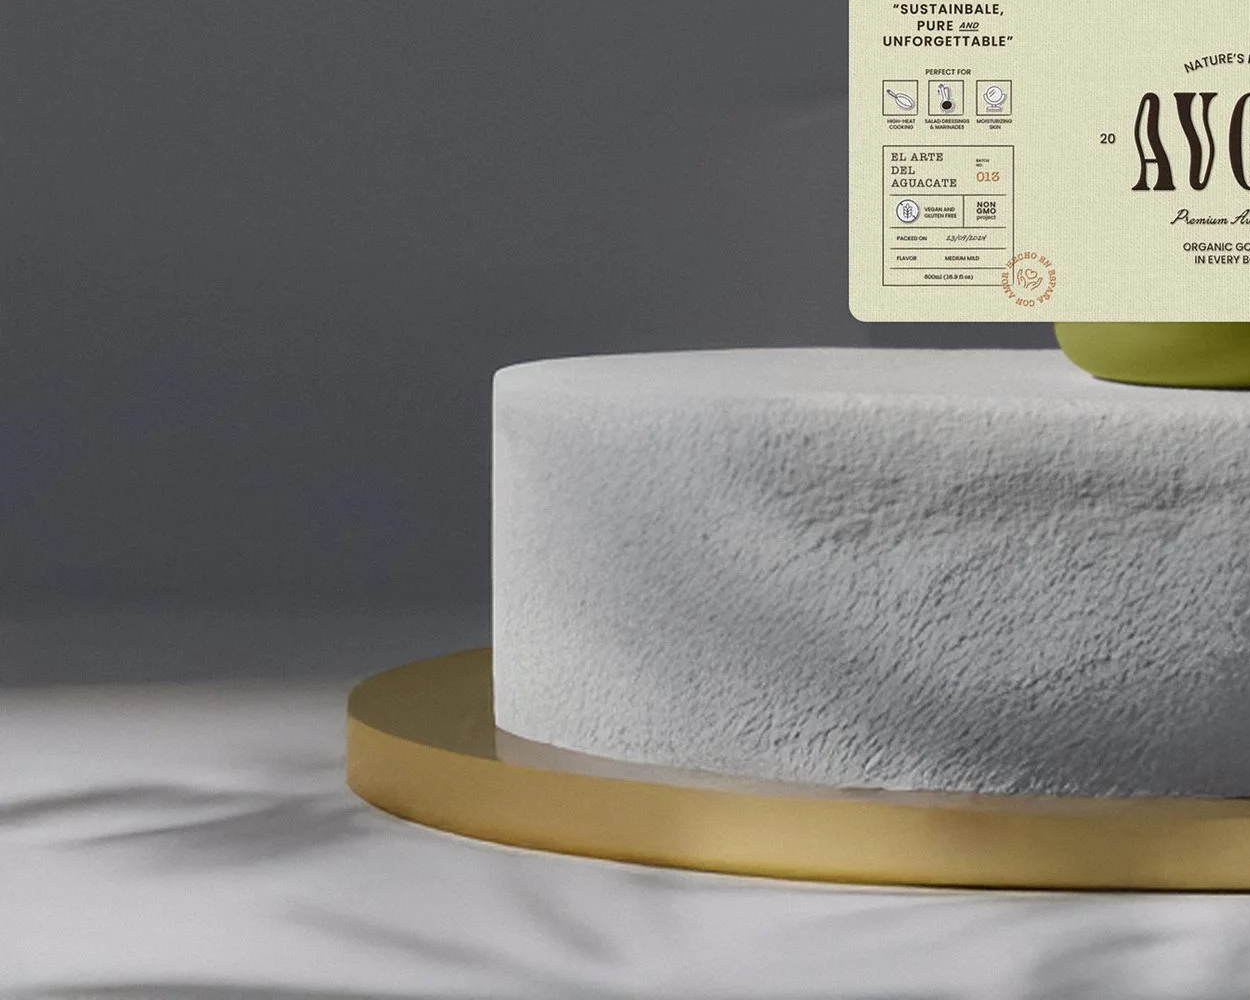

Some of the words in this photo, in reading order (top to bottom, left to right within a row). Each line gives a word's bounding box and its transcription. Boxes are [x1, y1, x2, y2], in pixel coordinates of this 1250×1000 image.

[893, 3, 1004, 15] “SUSTAINBALE,
[917, 21, 953, 31] PURE
[959, 22, 979, 31] AND
[883, 36, 1013, 47] UNFORGETTABLE”
[1099, 133, 1116, 144] 20
[891, 153, 906, 162] EL
[911, 153, 944, 162] ARTE
[891, 166, 915, 175] DEL
[976, 171, 1000, 182] 013
[891, 178, 957, 188] AGUACATE
[1170, 209, 1228, 225] Premium
[1183, 242, 1233, 252] ORGANIC
[1006, 252, 1037, 268] HECHO
[1039, 256, 1052, 268] EN
[1194, 255, 1205, 264] IN
[1208, 255, 1240, 264] EVERY
[1002, 272, 1016, 298] AMOR
[1016, 298, 1035, 307] CON
